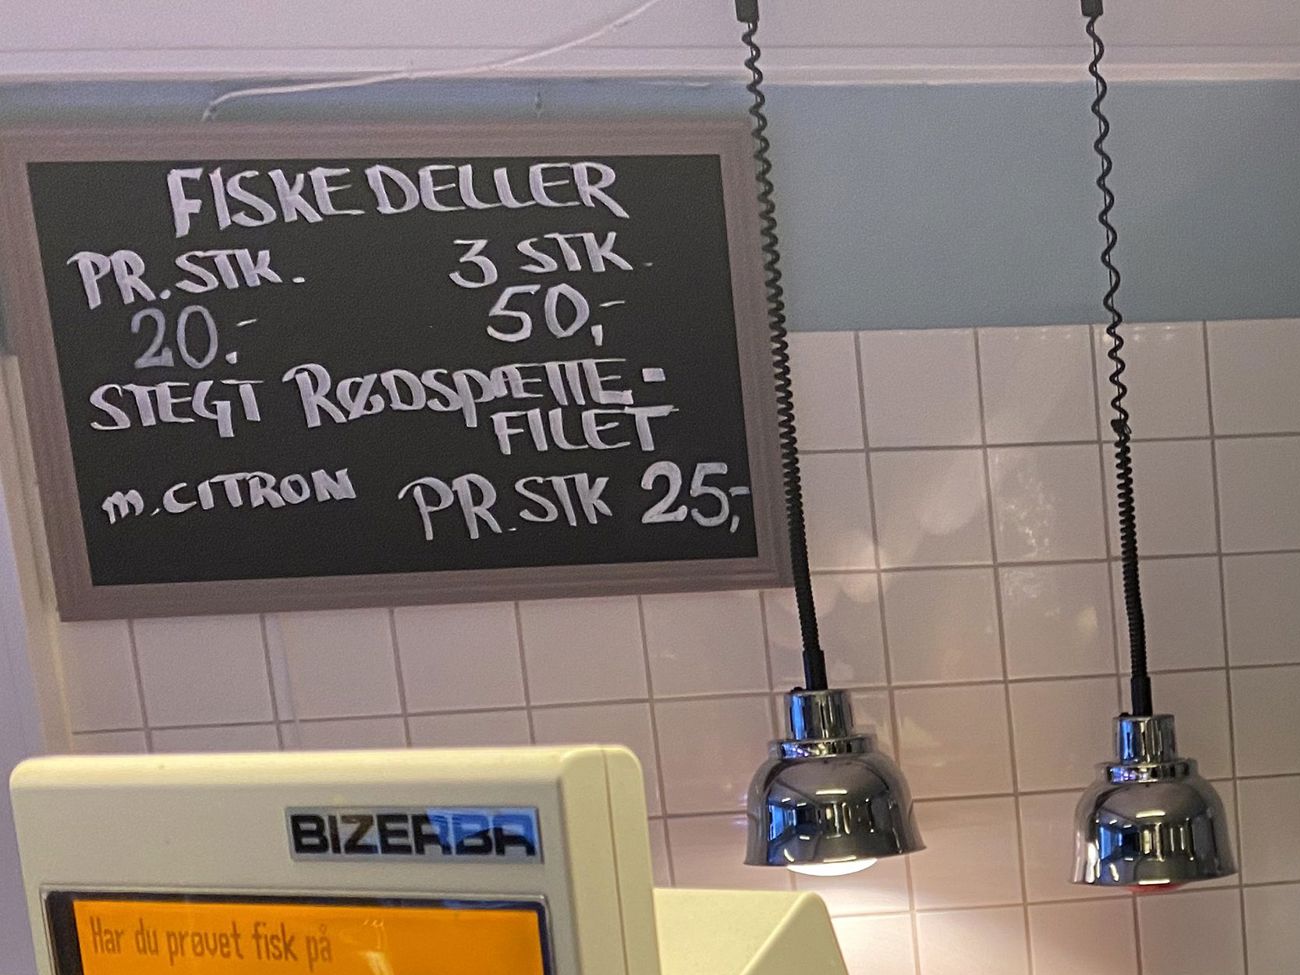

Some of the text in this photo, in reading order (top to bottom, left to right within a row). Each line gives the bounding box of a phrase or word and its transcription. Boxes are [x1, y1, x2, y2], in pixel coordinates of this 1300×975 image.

[449, 239, 498, 288] 3
[89, 379, 264, 438] STEGT
[490, 405, 680, 455] FILET
[290, 813, 537, 857] BIZERBA
[90, 916, 333, 972] Har du prøvet fisk på
